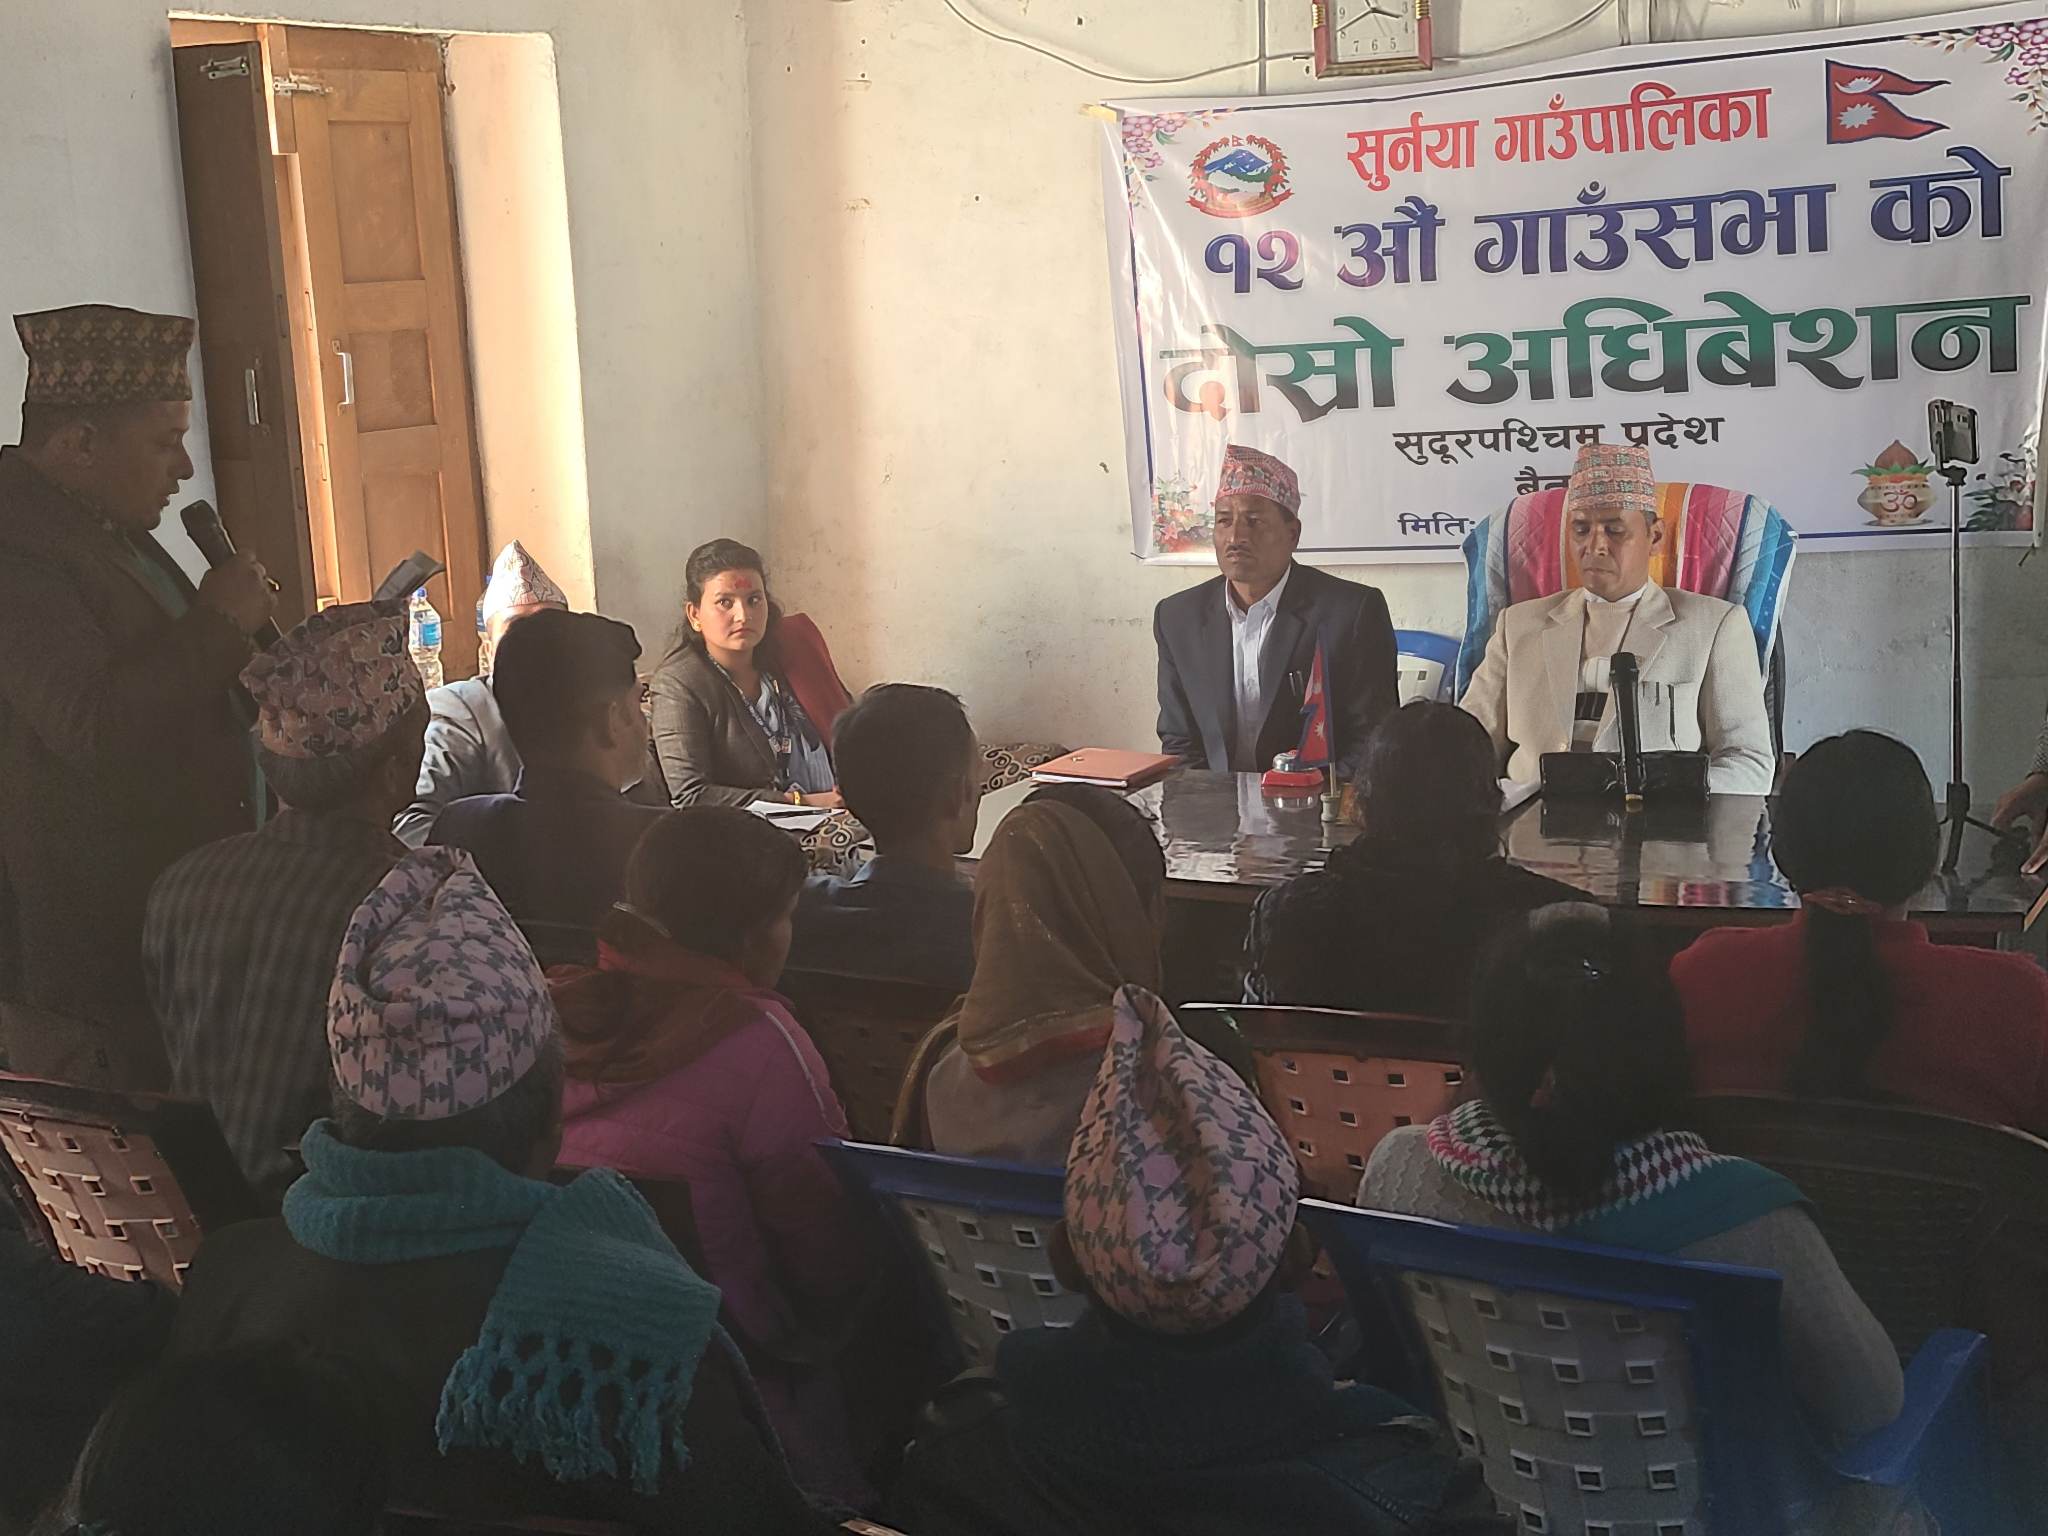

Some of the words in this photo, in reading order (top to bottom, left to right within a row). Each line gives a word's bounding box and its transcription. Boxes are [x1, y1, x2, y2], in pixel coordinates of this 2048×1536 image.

[1347, 112, 1479, 191] सुर्नया
[1494, 81, 1772, 164] गाउँपालिका
[1204, 230, 1303, 293] १२
[1334, 196, 1446, 288] औ
[1474, 181, 1837, 275] गाउँसभा
[1870, 146, 2012, 244] को
[1159, 316, 1405, 422] दोस्रो
[1443, 290, 2031, 405] अधिबेशन
[1393, 418, 1605, 465] सुदूरपश्चिम
[1621, 412, 1726, 450] प्रदेश
